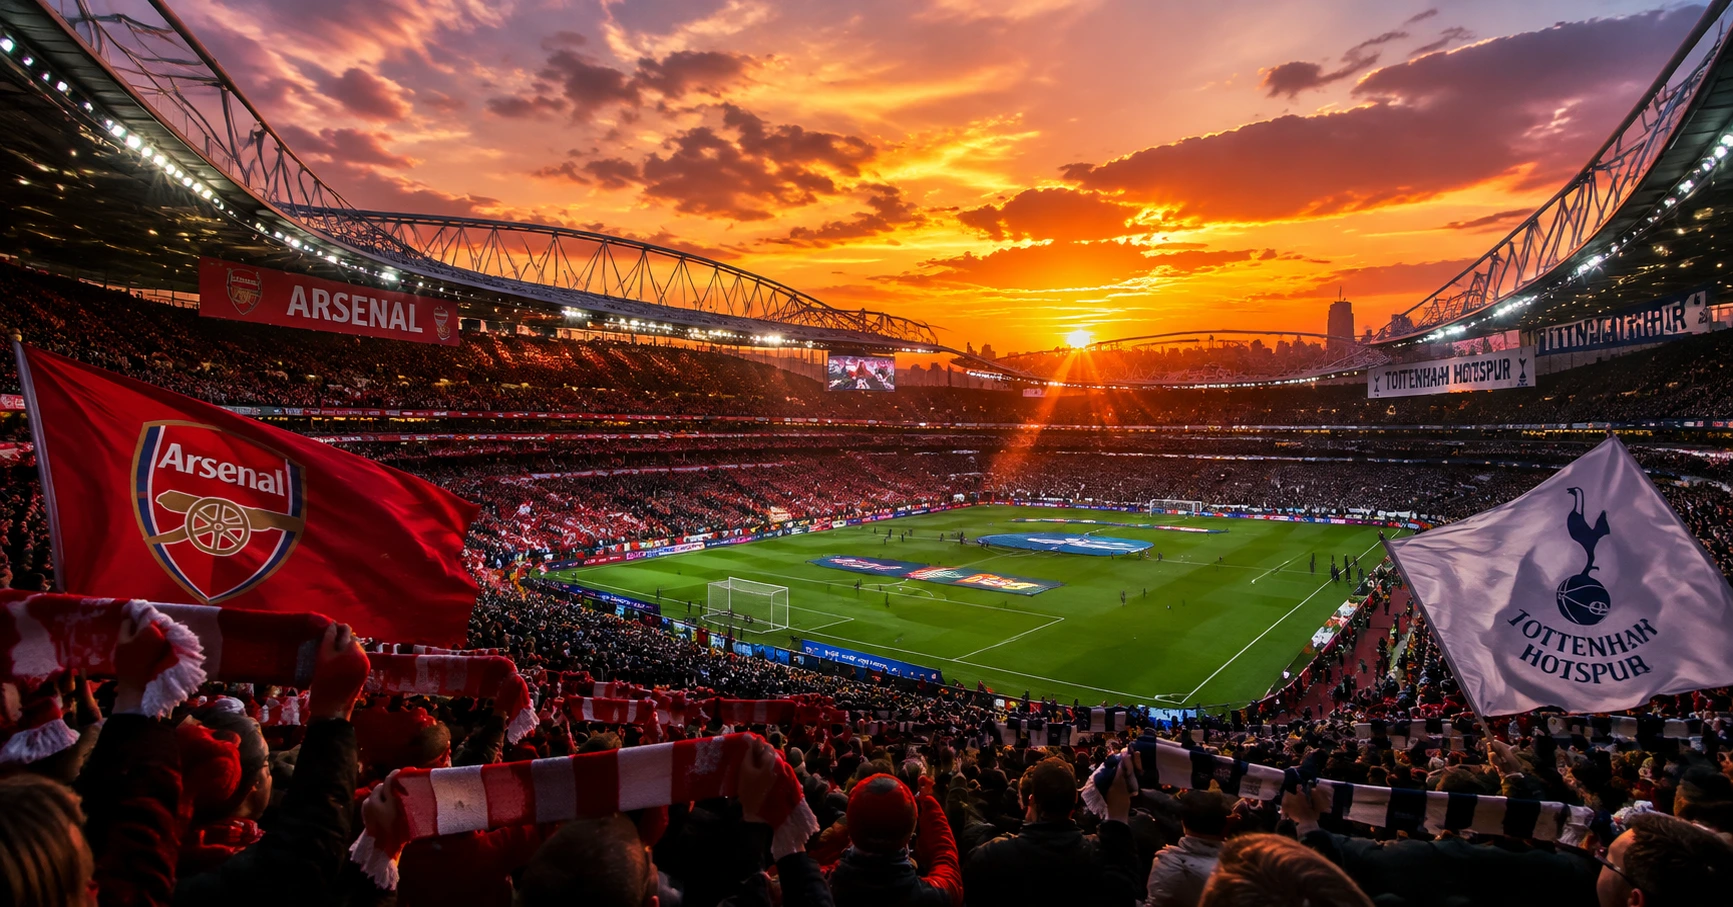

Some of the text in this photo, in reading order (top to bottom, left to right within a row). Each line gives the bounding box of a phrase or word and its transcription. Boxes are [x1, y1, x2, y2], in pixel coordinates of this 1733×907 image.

[286, 285, 423, 333] ARSENAL
[157, 442, 285, 497] Arsenal
[1519, 643, 1651, 684] HOTSPUR
